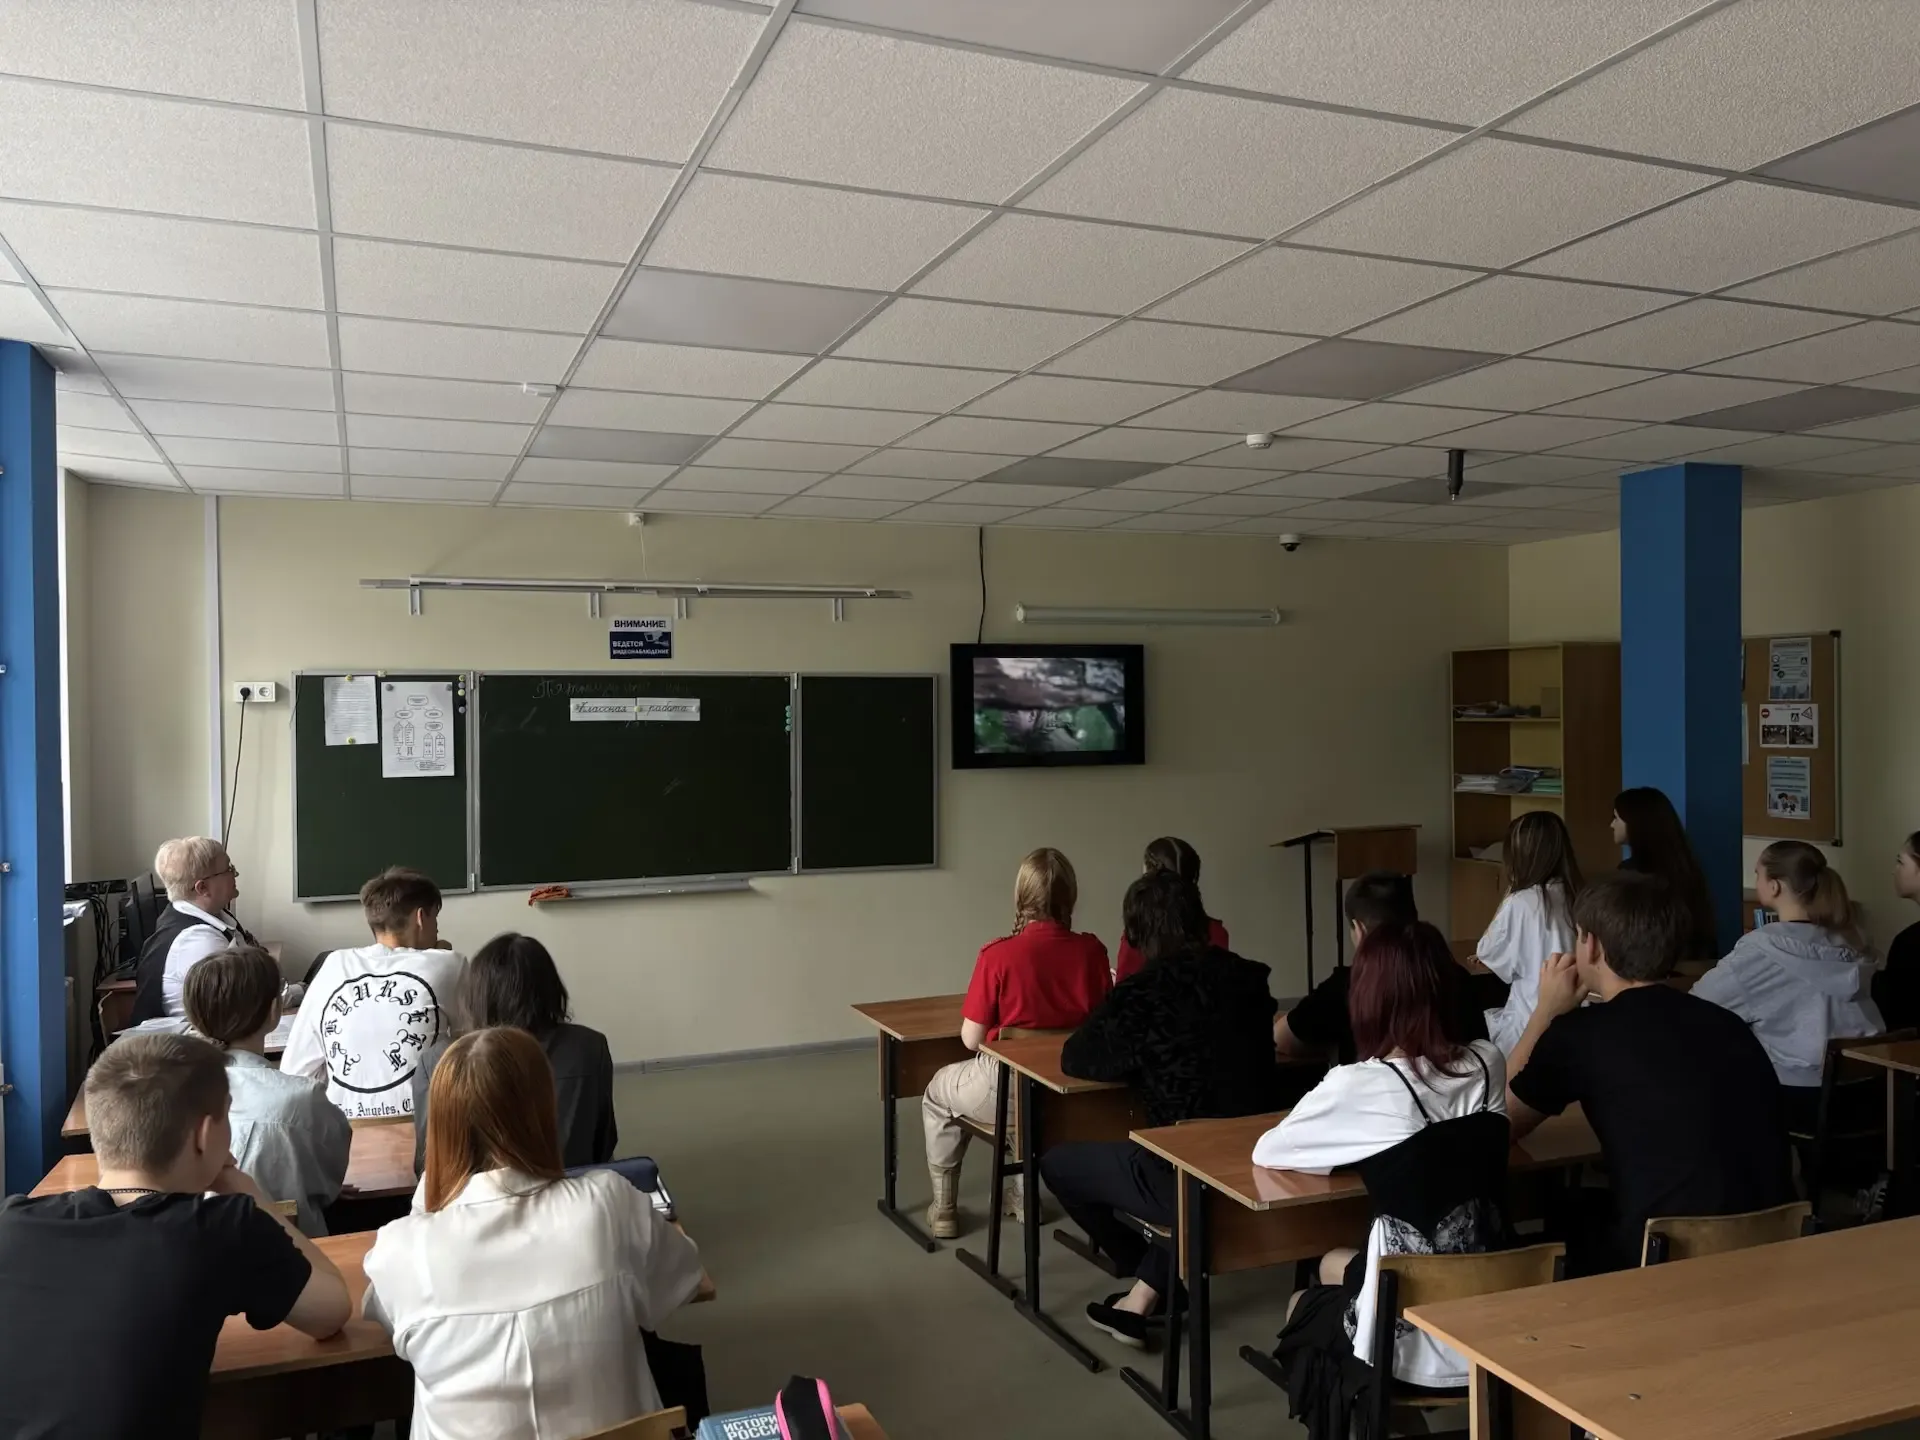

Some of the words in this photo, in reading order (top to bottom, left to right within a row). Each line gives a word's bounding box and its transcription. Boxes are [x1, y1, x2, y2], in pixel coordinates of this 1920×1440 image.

[614, 619, 667, 628] ВНИМАНИЕ!
[612, 640, 644, 648] ВЕДЕТСЯ
[574, 701, 627, 713] Классная
[646, 701, 688, 716] работа
[723, 1414, 778, 1433] ИСТОРИ
[727, 1423, 781, 1440] РОССИ
